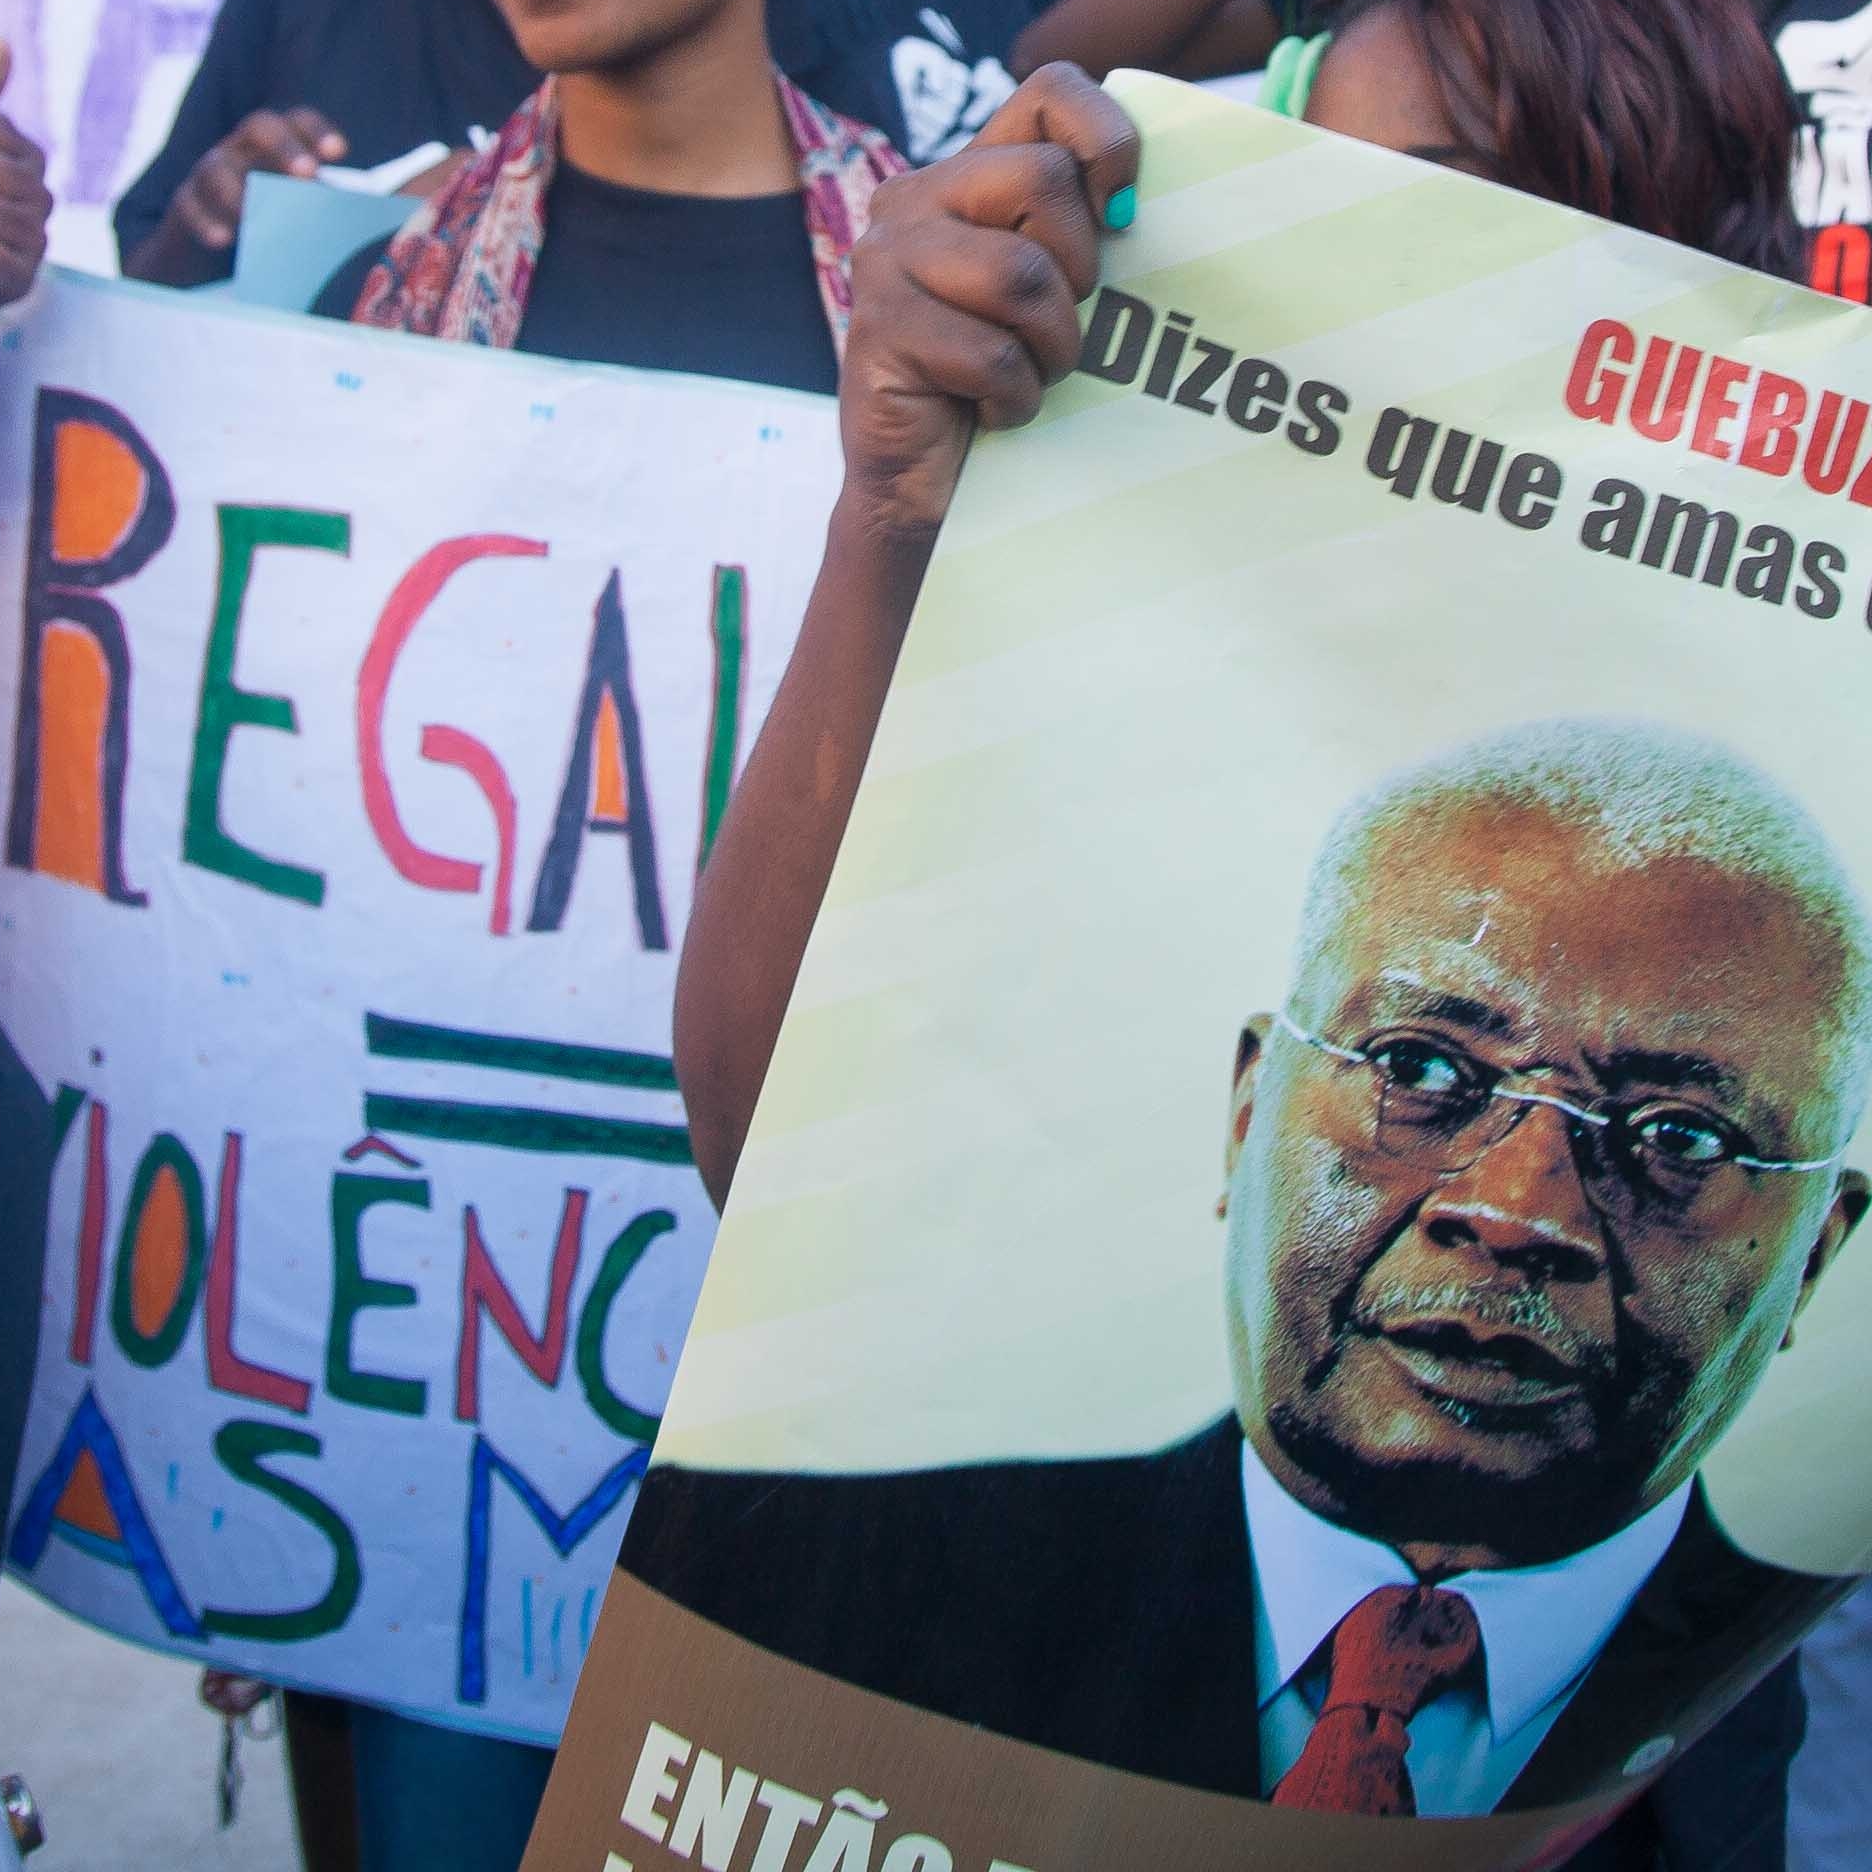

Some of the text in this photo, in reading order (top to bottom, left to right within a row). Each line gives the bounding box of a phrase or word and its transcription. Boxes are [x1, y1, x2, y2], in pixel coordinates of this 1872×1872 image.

[1079, 283, 1350, 459] Dizes
[1363, 403, 1560, 534] que
[1580, 478, 1849, 623] amas
[53, 1083, 678, 1445] IOLÊNC
[9, 1385, 363, 1640] AS
